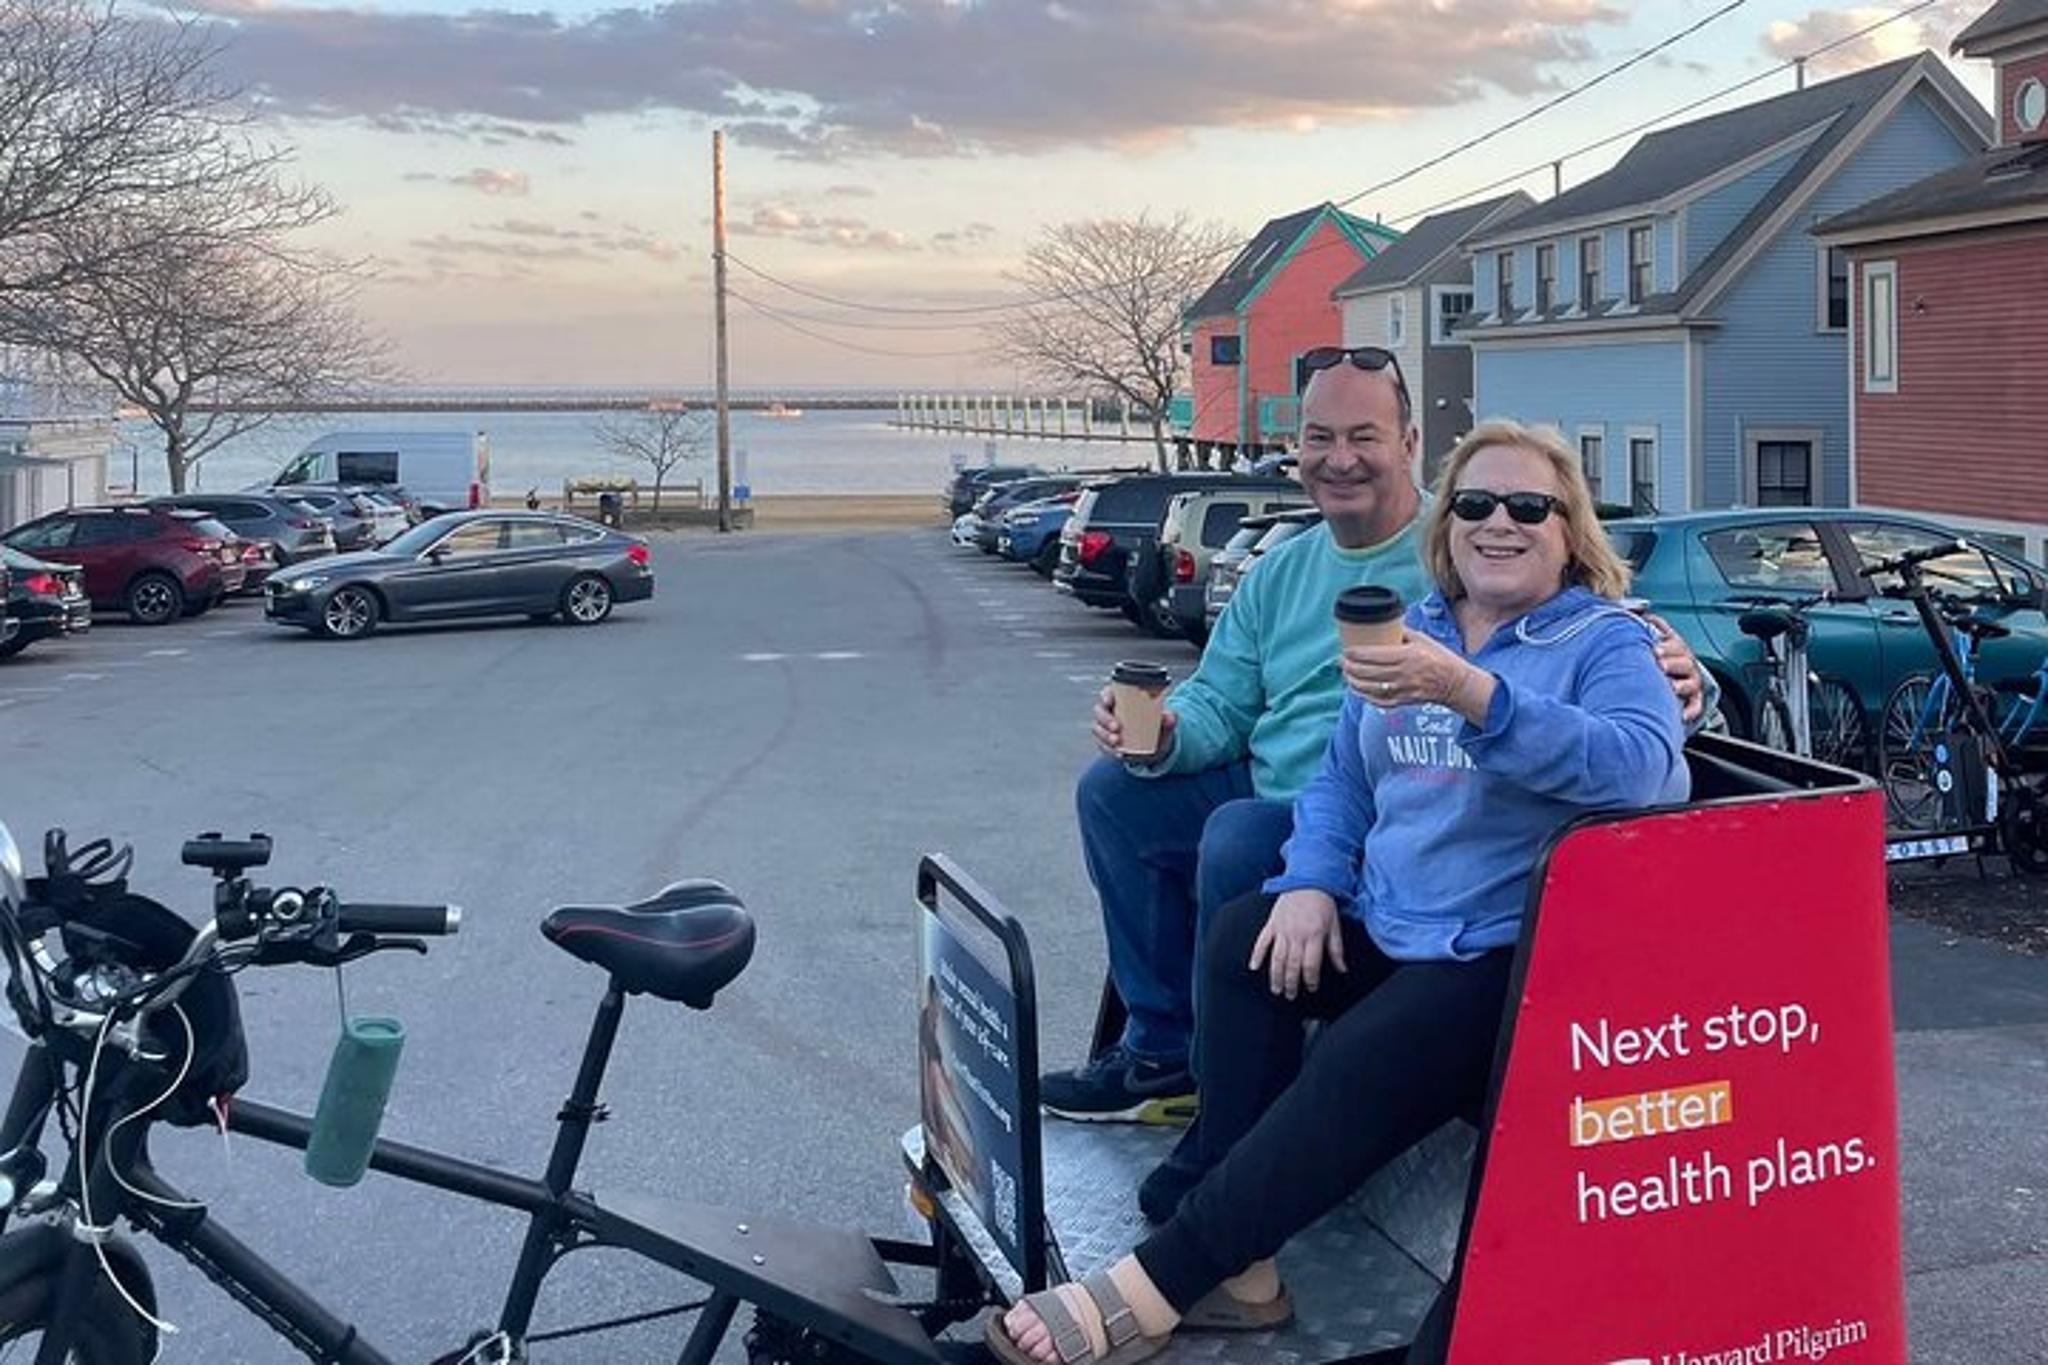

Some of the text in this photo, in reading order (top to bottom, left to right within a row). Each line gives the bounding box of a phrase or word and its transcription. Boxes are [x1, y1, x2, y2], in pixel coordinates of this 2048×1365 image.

[1570, 1002, 1820, 1071] Next stop,
[1573, 1089, 1726, 1146] better
[1577, 1136, 1876, 1223] health plans.
[1776, 1318, 1867, 1360] Pilgrim
